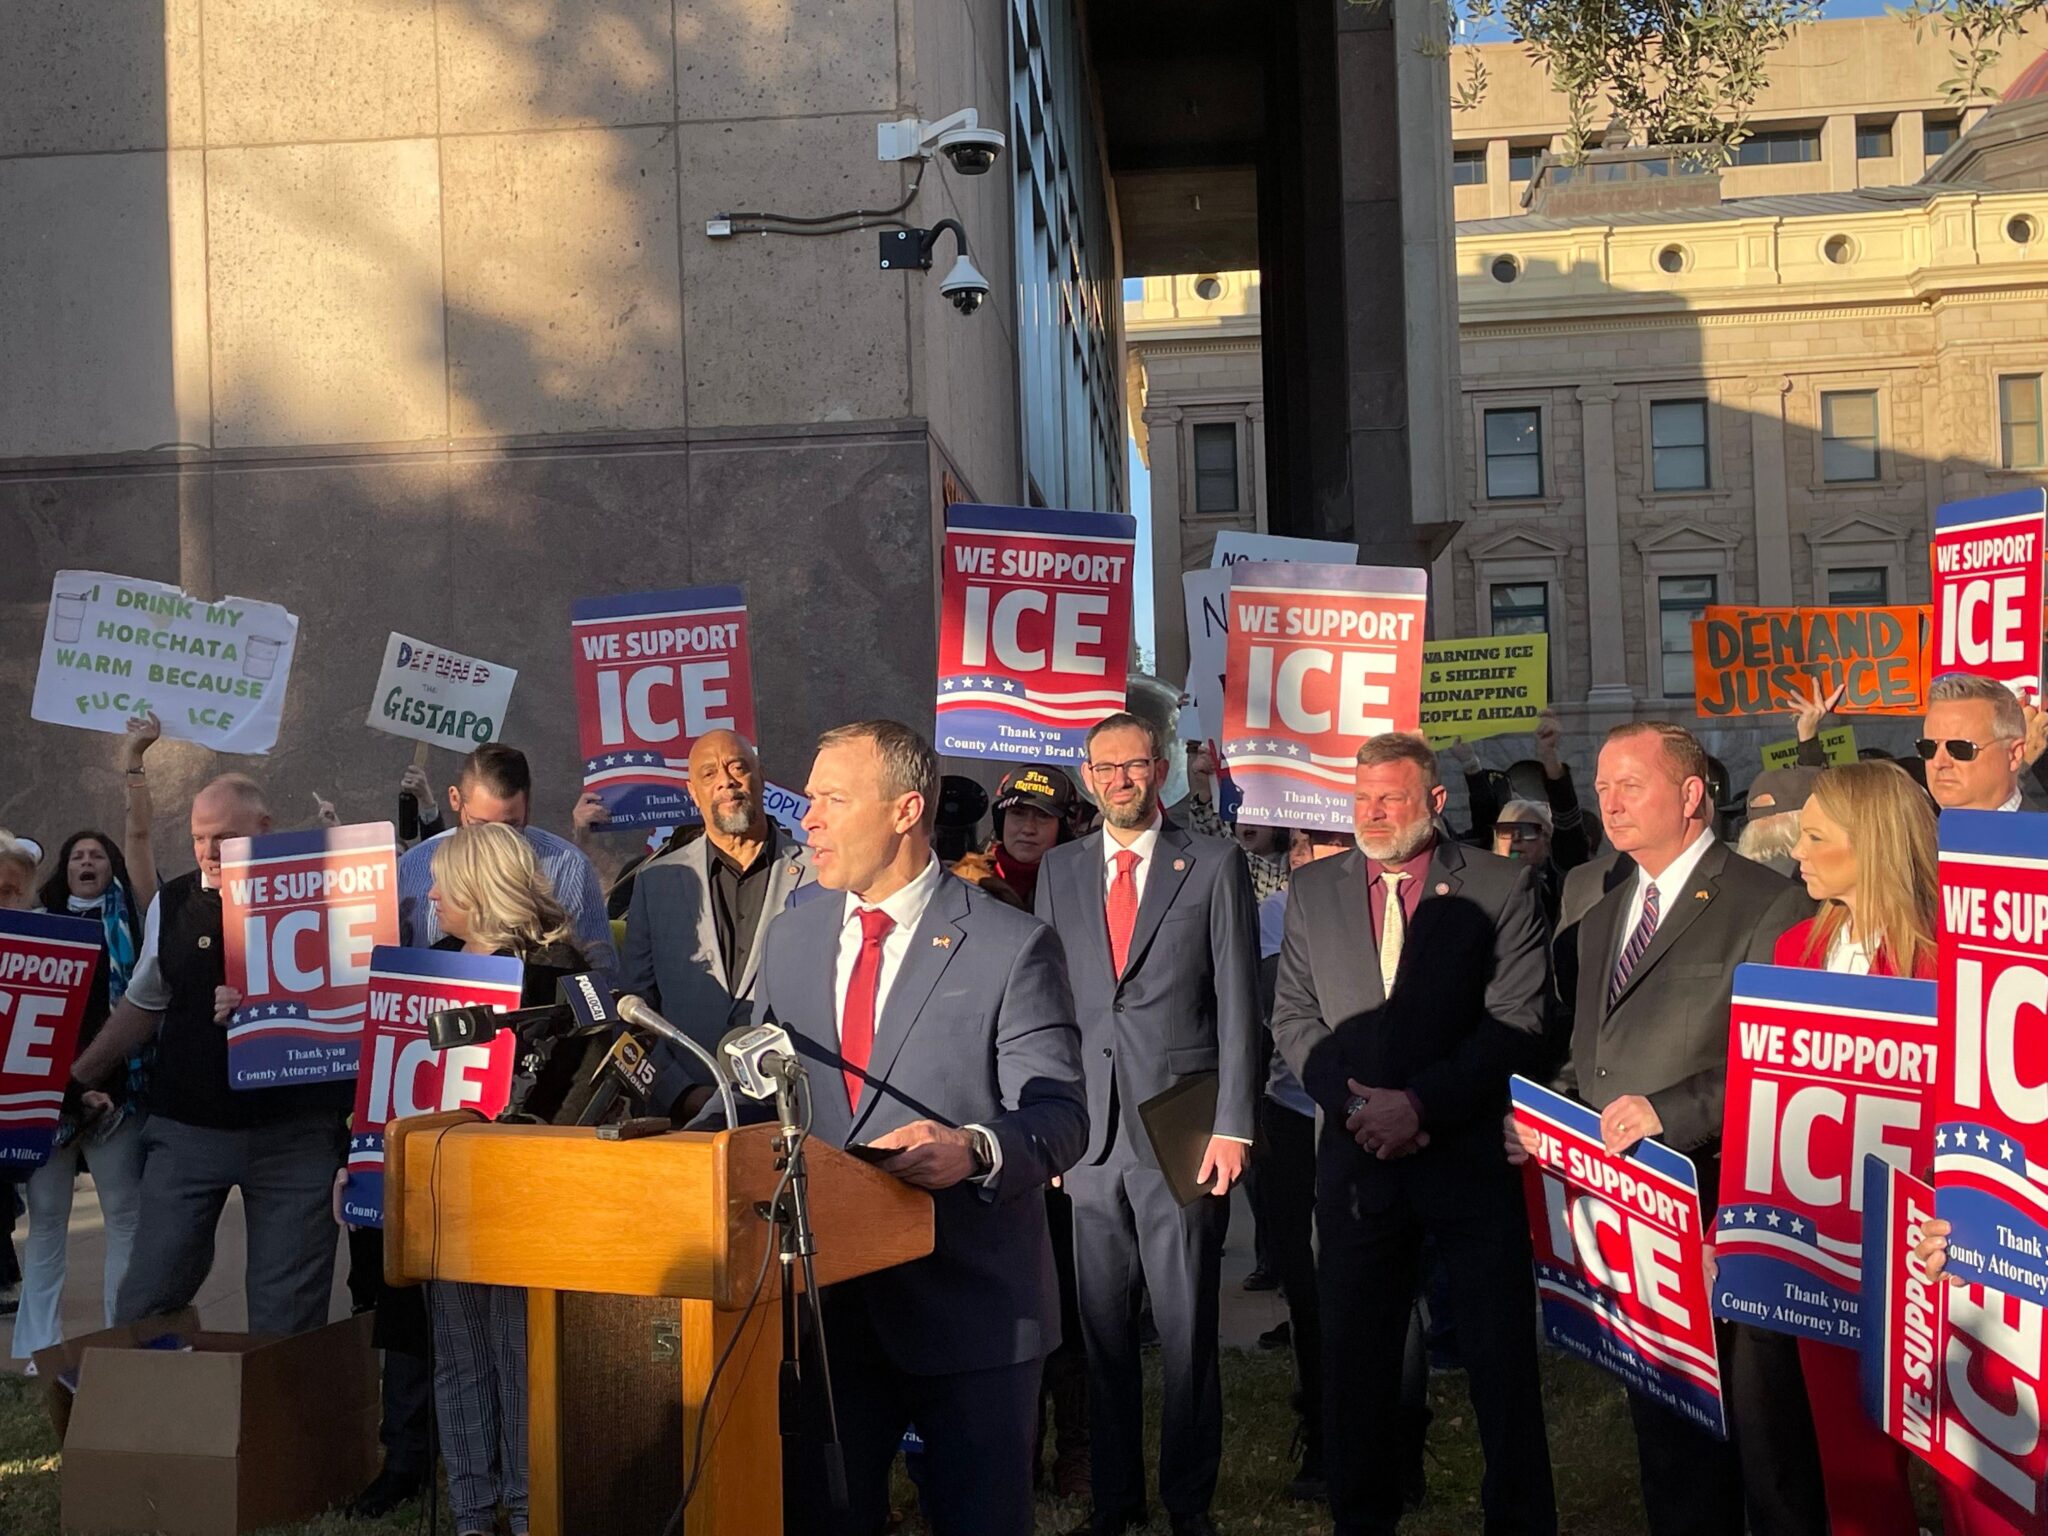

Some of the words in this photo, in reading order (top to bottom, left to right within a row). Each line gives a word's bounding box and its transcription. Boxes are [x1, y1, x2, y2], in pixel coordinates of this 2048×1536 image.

[954, 545, 996, 576] WE
[1000, 548, 1126, 584] SUPPORT
[1937, 543, 1960, 573] WE
[1963, 532, 2036, 570] SUPPORT
[91, 584, 100, 602] I
[115, 588, 193, 620] DRINK
[205, 605, 244, 628] MY
[1238, 604, 1281, 634] WE
[1285, 605, 1415, 642] SUPPORT
[1941, 575, 2026, 666] ICE
[96, 620, 238, 662] HORCHATA
[582, 633, 621, 661] WE
[626, 623, 739, 658] SUPPORT
[961, 585, 1110, 676] ICE
[1706, 611, 1903, 669] DEMAND
[396, 641, 491, 687] DEFUND
[1505, 645, 1533, 659] ICE
[56, 648, 132, 677] WARM
[148, 664, 264, 700] BECAUSE
[1246, 645, 1398, 737] ICE
[1430, 670, 1441, 683] &
[1446, 666, 1517, 683] SHERIFF
[1702, 657, 1919, 715] JUSTICE
[76, 692, 152, 718] FUCK
[187, 707, 234, 731] ICE
[383, 686, 493, 743] GESTAPO
[597, 660, 736, 745] ICE
[1420, 708, 1473, 724] EOPLE
[1477, 705, 1538, 721] AHEAD
[944, 736, 987, 751] County
[989, 740, 1042, 758] Attorney
[1045, 744, 1074, 758] Brad
[998, 725, 1037, 739] Thank
[1039, 731, 1061, 743] you
[1827, 735, 1846, 747] ICE
[1024, 771, 1049, 784] Fire
[611, 814, 635, 824] unty
[763, 787, 811, 821] EOPL
[1228, 803, 1270, 820] County
[1273, 807, 1327, 824] Attorney
[1331, 811, 1353, 824] Bra
[1283, 790, 1322, 806] Thank
[1325, 796, 1348, 808] you
[230, 876, 269, 906] WE
[274, 863, 388, 902] SUPPORT
[1942, 884, 1987, 938] WE
[0, 951, 89, 987] UPPORT
[244, 903, 377, 997] ICE
[370, 990, 403, 1023] WE
[286, 1047, 323, 1061] Thank
[325, 1046, 346, 1060] you
[1739, 1021, 1787, 1066] WE
[1790, 1028, 1938, 1085] SUPPORT
[1954, 957, 2048, 1125] IC
[237, 1069, 277, 1082] County
[280, 1064, 330, 1077] Attorney
[332, 1060, 360, 1073] Brad
[367, 1034, 491, 1124] ICE
[614, 1060, 646, 1096] ARIZONA
[637, 1058, 657, 1085] 15
[1744, 1078, 1922, 1213] ICE
[1568, 1145, 1691, 1234] SUPPORT
[344, 1201, 380, 1222] County
[1541, 1172, 1692, 1332] ICE
[1996, 1224, 2043, 1259] Thank
[1948, 1239, 1986, 1274] ounty
[1988, 1254, 2048, 1296] Attorney
[1783, 1282, 1830, 1308] Thank
[1832, 1297, 1859, 1315] you
[1903, 1197, 1937, 1391] SUPPORT
[1721, 1292, 1771, 1321] County
[1772, 1305, 1835, 1336] Attorney
[1838, 1319, 1861, 1339] Br
[1601, 1337, 1638, 1368] Thank
[1639, 1361, 1662, 1382] you
[1596, 1353, 1644, 1388] Attorney
[1647, 1379, 1678, 1408] Brad
[1679, 1399, 1718, 1429] Miller
[1944, 1278, 2044, 1516] ICE
[1903, 1382, 1933, 1453] WE
